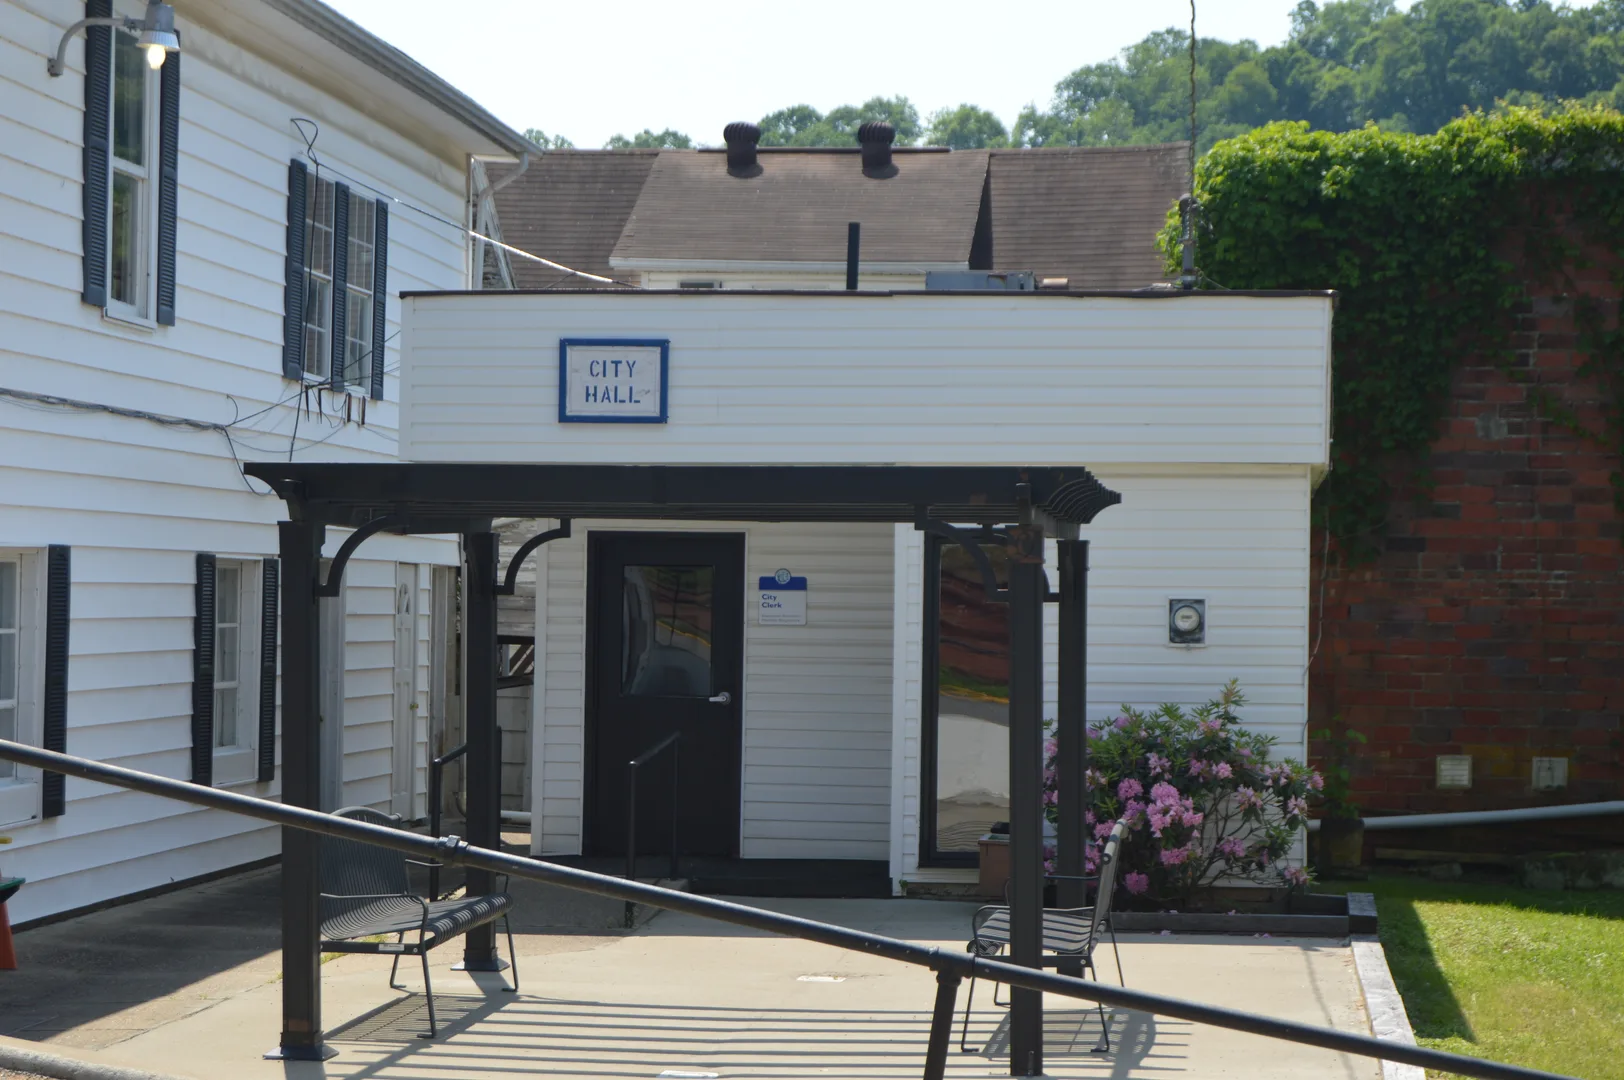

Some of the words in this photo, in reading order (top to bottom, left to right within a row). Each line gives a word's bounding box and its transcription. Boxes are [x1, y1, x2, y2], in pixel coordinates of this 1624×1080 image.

[589, 359, 637, 378] CITY
[585, 385, 641, 404] HALL
[761, 593, 777, 602] City
[761, 601, 782, 609] Clerk
